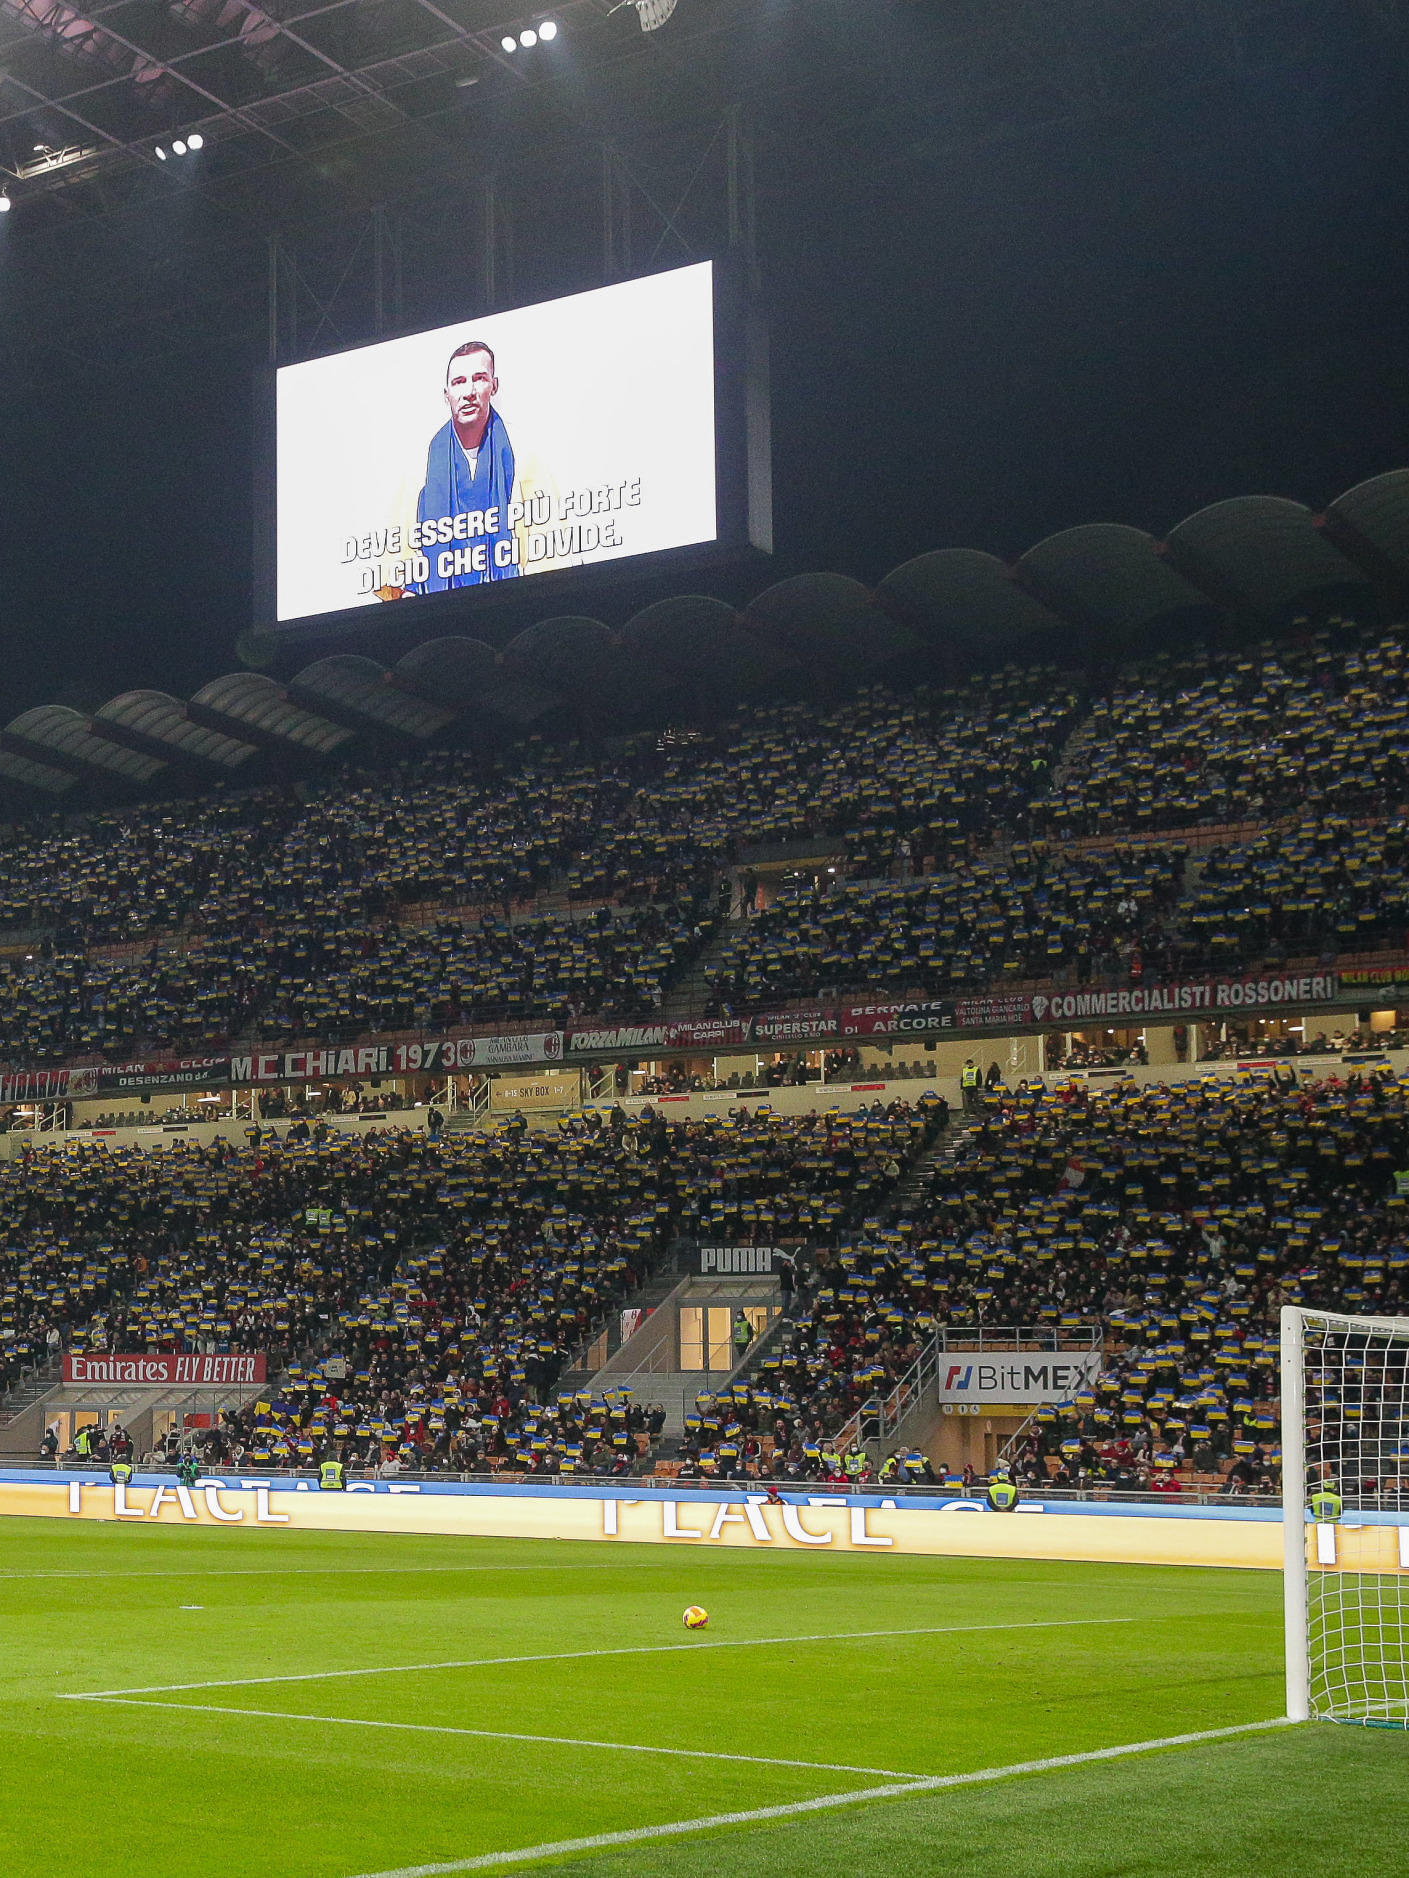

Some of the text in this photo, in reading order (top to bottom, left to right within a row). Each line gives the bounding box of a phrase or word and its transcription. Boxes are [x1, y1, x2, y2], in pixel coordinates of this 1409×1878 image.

[341, 476, 641, 563] DEVE ESSERE PIÙ FORTE
[358, 564, 382, 594] DI
[392, 547, 430, 587] CIÒ
[437, 546, 487, 579] CHE
[527, 520, 624, 563] DIVIDE.
[1051, 976, 1332, 1018] COMMERCIALISTI ROSSONERI
[851, 1001, 943, 1016] BERNATE
[677, 1019, 740, 1032] MILAN CLUB
[693, 1030, 725, 1040] CARPI
[755, 1020, 837, 1036] SUPERSTAR
[844, 1016, 952, 1035] DI ARCORE
[570, 1024, 666, 1051] FORZA MILAN
[397, 1041, 457, 1071] 1973
[101, 1064, 144, 1075] MILAN
[119, 1072, 193, 1086] DESENZANO
[520, 1088, 533, 1098] SKY
[535, 1086, 550, 1097] BOX
[701, 1247, 772, 1272] PUMA
[70, 1356, 256, 1382] Emirates FLY BETTER
[978, 1365, 1096, 1391] BitMEX
